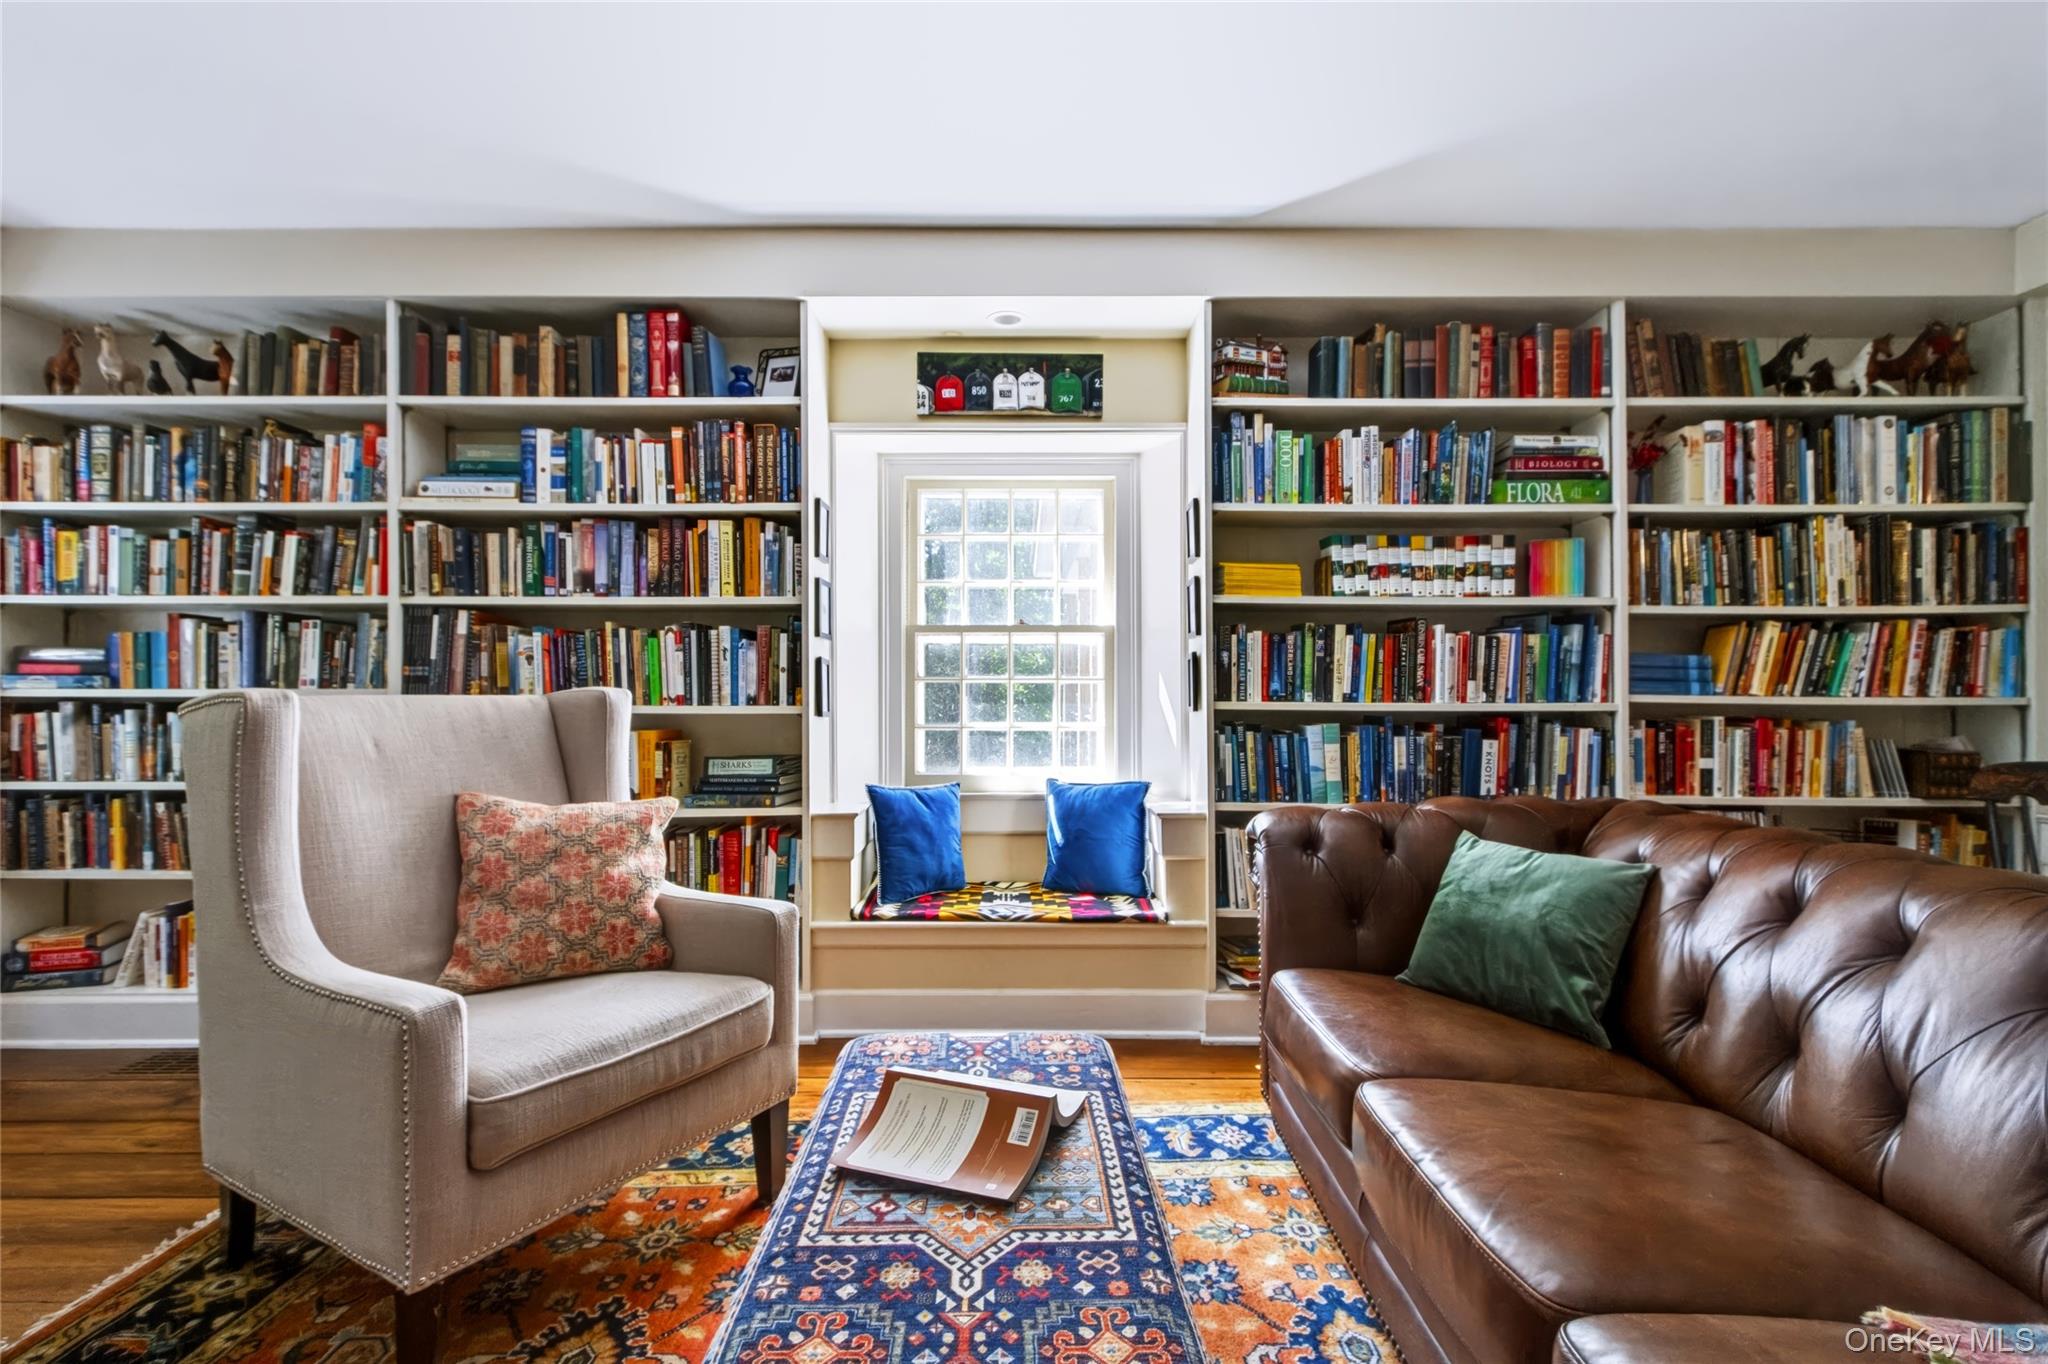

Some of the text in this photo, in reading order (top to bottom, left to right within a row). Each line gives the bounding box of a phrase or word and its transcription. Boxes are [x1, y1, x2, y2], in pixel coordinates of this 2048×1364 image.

[971, 386, 987, 396] 850
[1280, 434, 1292, 467] 1000
[1507, 482, 1566, 503] FLORA
[1417, 620, 1426, 648] COSMOS
[1416, 665, 1425, 687] SAGAN
[720, 760, 752, 768] SHARKS
[1484, 751, 1493, 784] KNOTS
[30, 957, 89, 967] DICTIONARY
